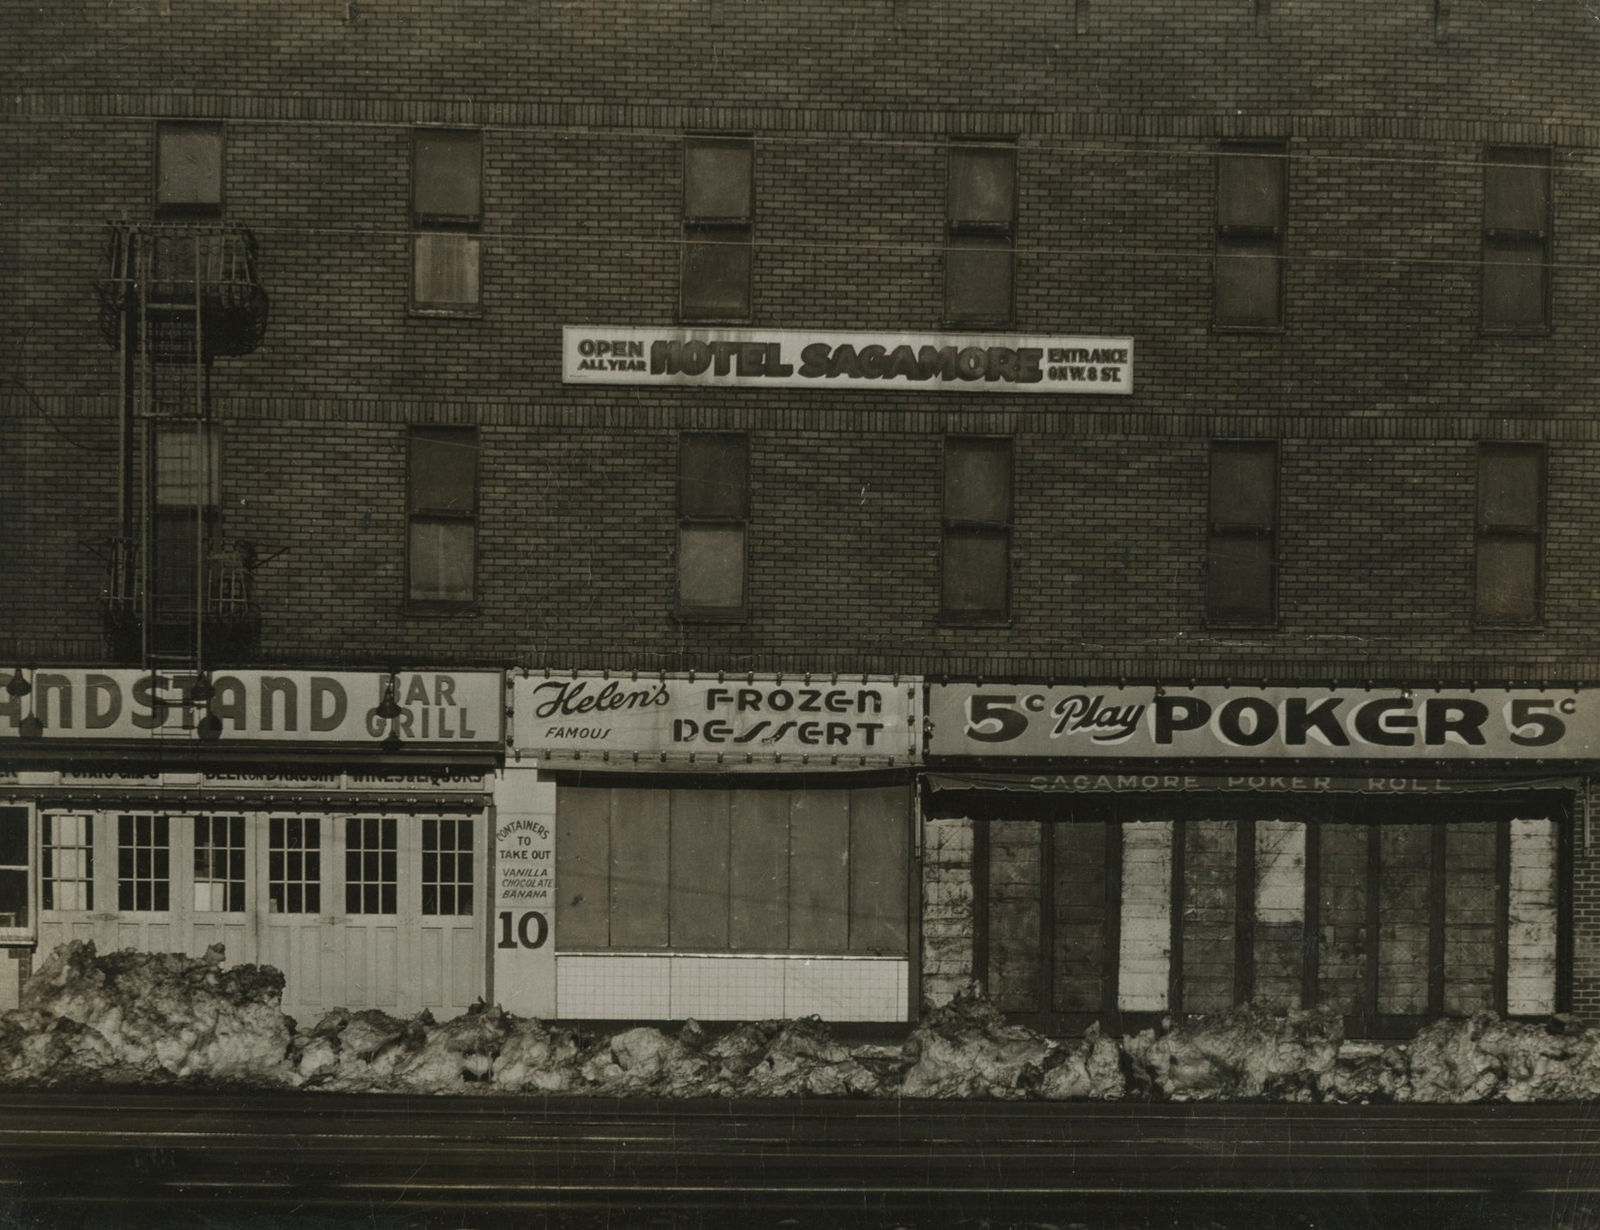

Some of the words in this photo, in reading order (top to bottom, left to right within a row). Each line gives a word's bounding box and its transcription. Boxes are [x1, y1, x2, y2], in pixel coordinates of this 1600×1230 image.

[577, 339, 645, 358] OPEN
[1047, 348, 1128, 364] ENTRANCE
[577, 359, 608, 371] ALL
[608, 360, 647, 372] YEAR
[650, 340, 794, 377] HOTEL
[797, 342, 1044, 383] SAGAMORE
[1047, 366, 1068, 382] ON
[1068, 366, 1087, 381] W.
[1087, 367, 1098, 382] 8
[1102, 366, 1122, 382] ST.
[379, 674, 457, 706] BAR
[532, 681, 671, 719] Helen's
[706, 687, 883, 713] FROZEN
[366, 707, 476, 738] GRILL
[1050, 694, 1146, 745] Play
[1148, 695, 1490, 747] POKER
[544, 726, 613, 740] FAMOUS
[672, 718, 885, 746] DESSERT
[1368, 777, 1452, 792] ROLL
[495, 820, 549, 841] CONTAINERS
[517, 836, 531, 846] TO
[499, 850, 529, 860] TAKE
[531, 850, 552, 860] OUT
[502, 868, 547, 877] VANILLA
[501, 878, 552, 888] CHOCOLATE
[502, 890, 547, 899] BANANA
